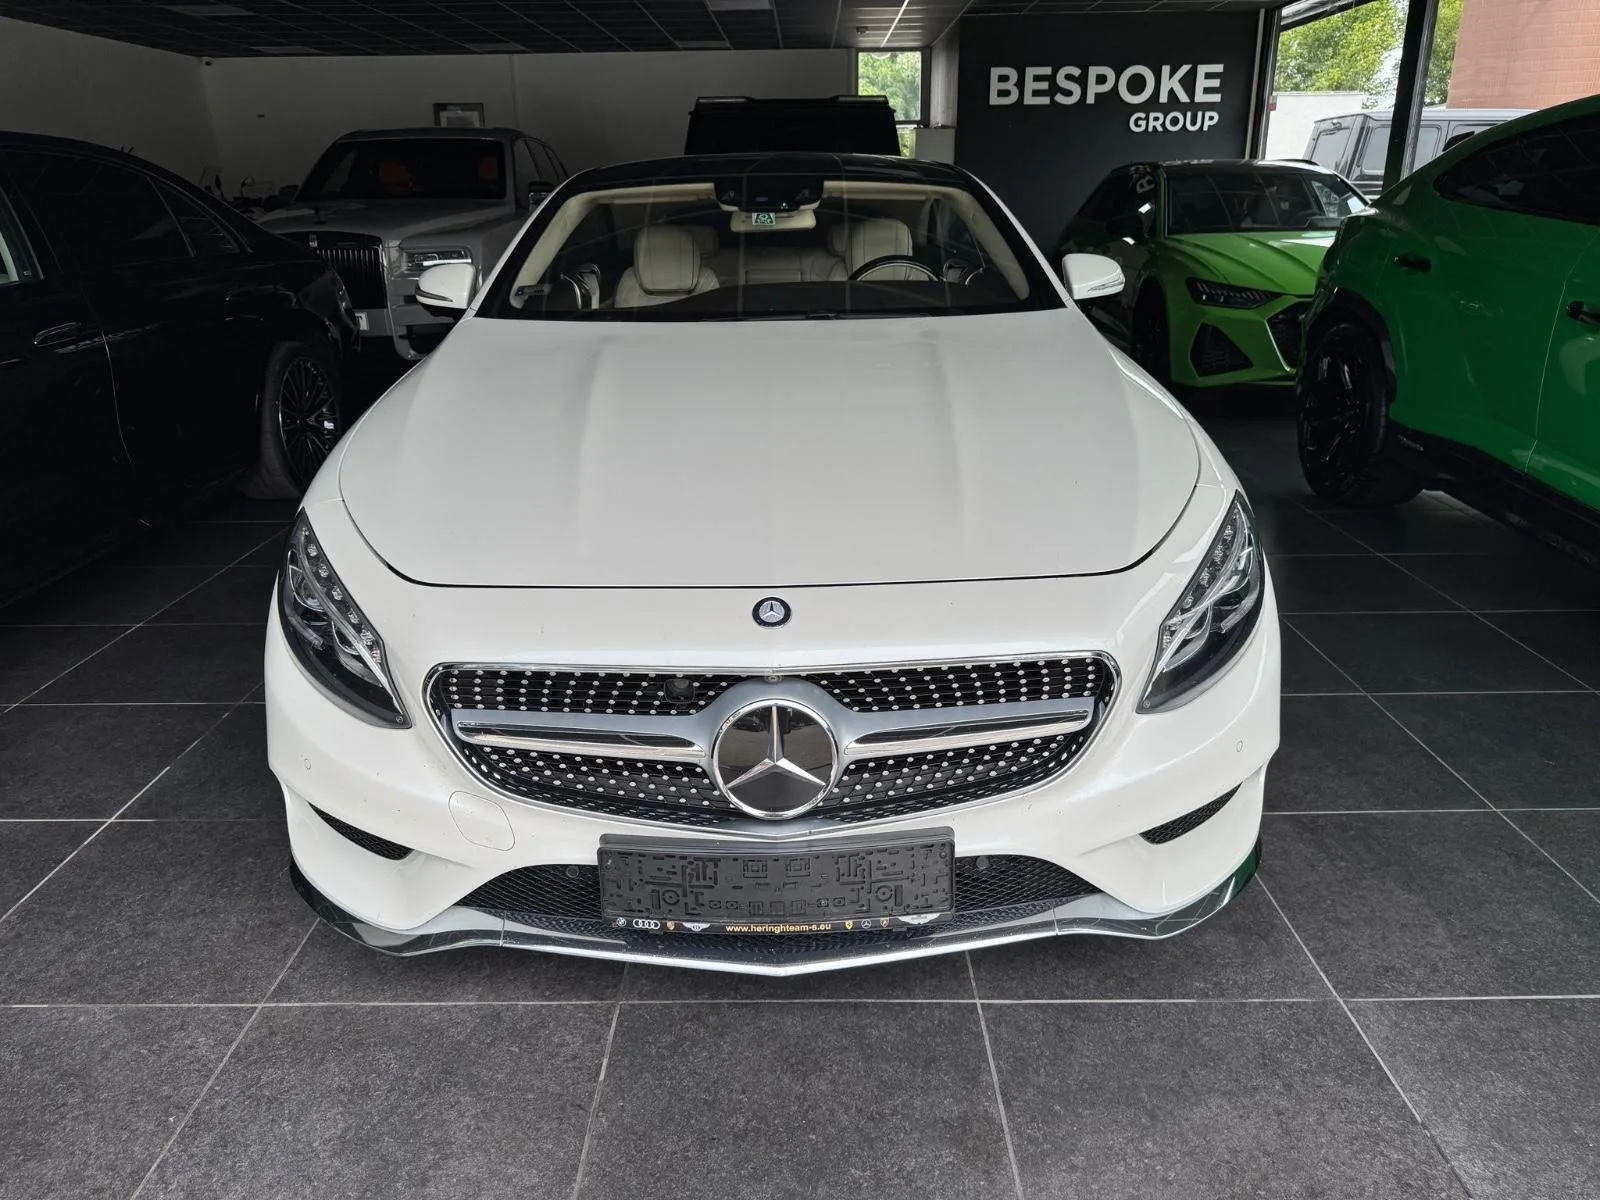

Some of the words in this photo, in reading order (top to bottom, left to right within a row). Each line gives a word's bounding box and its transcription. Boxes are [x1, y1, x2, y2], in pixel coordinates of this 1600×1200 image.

[989, 64, 1224, 105] BESPOKE
[1129, 111, 1219, 133] GROUP
[725, 923, 832, 934] www.heringhteam-s.eu
